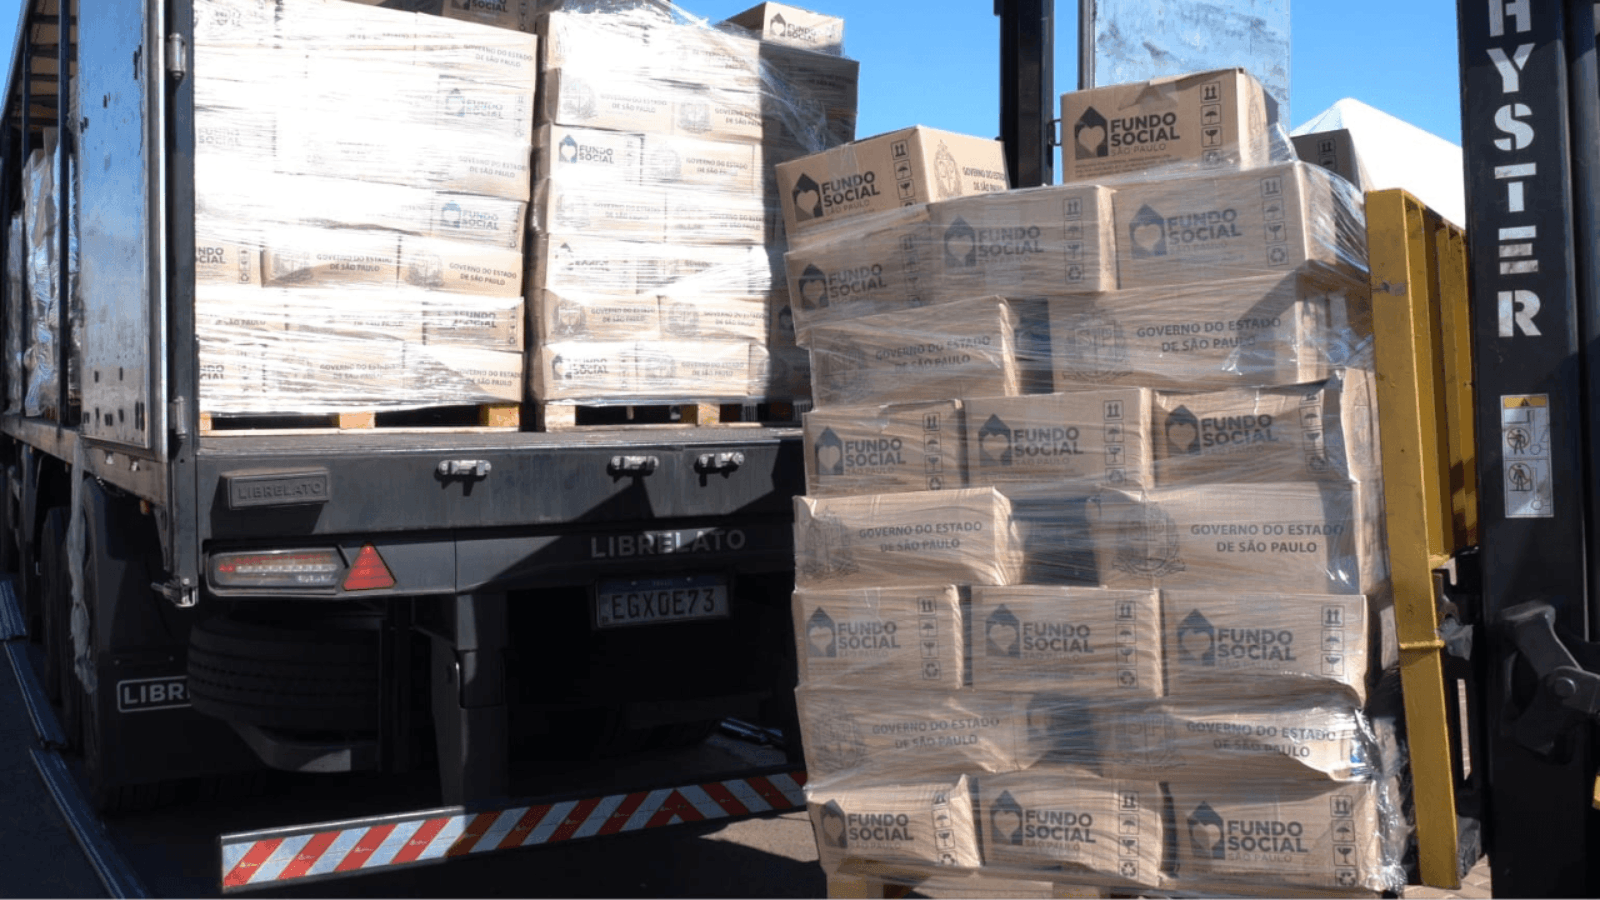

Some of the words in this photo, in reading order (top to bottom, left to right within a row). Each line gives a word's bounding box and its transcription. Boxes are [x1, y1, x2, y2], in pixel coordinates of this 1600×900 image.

[1110, 112, 1177, 133] FUNDO
[1110, 126, 1181, 147] SOCIAL
[579, 145, 614, 155] FUNDO
[1133, 143, 1167, 153] PAULO
[578, 152, 615, 164] SOCIAL
[1486, 0, 1542, 338] HYSTER
[821, 171, 876, 195] FUNDO
[823, 184, 881, 207] SOCIAL
[1168, 208, 1238, 231] FUNDO
[978, 225, 1041, 243] FUNDO
[1169, 223, 1242, 244] SOCIAL
[978, 240, 1044, 257] SOCIAL
[449, 262, 481, 273] GOVERNO
[482, 266, 492, 274] DO
[460, 272, 469, 280] DE
[829, 264, 883, 286] FUNDO
[829, 276, 887, 299] SOCIAL
[1136, 323, 1201, 338] GOVERNO
[1204, 321, 1224, 332] DO
[1228, 317, 1281, 331] ESTADO
[875, 344, 925, 360] GOVERNO
[928, 343, 944, 352] DO
[1161, 341, 1179, 352] DE
[1181, 338, 1209, 351] SÃO
[933, 354, 972, 366] PAULO
[1201, 414, 1272, 431] FUNDO
[1013, 427, 1080, 443] FUNDO
[1202, 428, 1280, 448] SOCIAL
[844, 438, 902, 454] FUNDO
[1014, 441, 1084, 457] SOCIAL
[845, 451, 907, 467] SOCIAL
[238, 482, 321, 499] LIBRELATO
[859, 525, 912, 538] GOVERNO
[915, 524, 932, 535] DO
[935, 521, 982, 534] ESTADO
[1190, 524, 1259, 535] GOVERNO
[1262, 524, 1284, 535] DO
[1288, 524, 1344, 535] ESTADO
[591, 530, 746, 557] LIBRELATO
[880, 543, 895, 552] DE
[897, 540, 920, 551] SÃO
[921, 538, 961, 550] PAULO
[1216, 541, 1235, 552] DE
[1237, 539, 1267, 553] SÃO
[1270, 541, 1317, 553] PAULO
[838, 621, 897, 635] FUNDO
[1023, 622, 1091, 638] FUNDO
[838, 636, 902, 649] SOCIAL
[1023, 636, 1094, 653] SOCIAL
[1218, 628, 1293, 646] FUNDO
[1217, 643, 1297, 662] SOCIAL
[124, 682, 191, 705] LIBR
[872, 721, 927, 734] GOVERNO
[929, 720, 948, 731] DO
[951, 717, 1000, 730] ESTADO
[1186, 721, 1252, 735] GOVERNO
[1255, 725, 1277, 737] DO
[1281, 727, 1336, 742] ESTADO
[912, 735, 936, 746] SÃO
[938, 734, 978, 746] PAULO
[847, 813, 909, 827] FUNDO
[1025, 809, 1093, 827] FUNDO
[848, 827, 914, 842] SOCIAL
[1025, 824, 1097, 844] SOCIAL
[1227, 820, 1303, 837] FUNDO
[1228, 835, 1309, 853] SOCIAL
